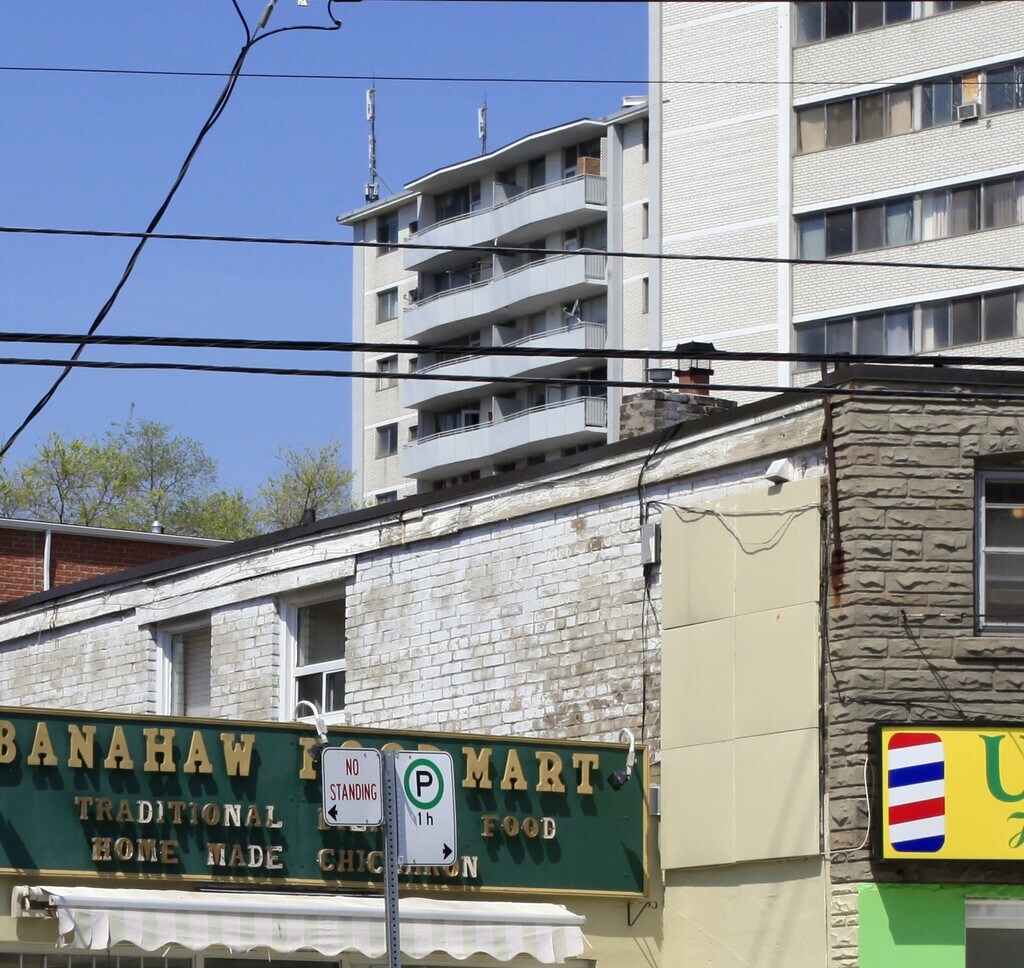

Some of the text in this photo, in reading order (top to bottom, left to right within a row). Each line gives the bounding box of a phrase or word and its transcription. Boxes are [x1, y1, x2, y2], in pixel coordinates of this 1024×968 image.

[345, 758, 359, 776] NO
[462, 746, 600, 795] MART
[330, 783, 378, 801] STANDING
[415, 770, 434, 798] P
[74, 796, 557, 840] TRADITIONAL FOOD
[91, 836, 179, 864] HOME
[206, 842, 284, 870] MADE
